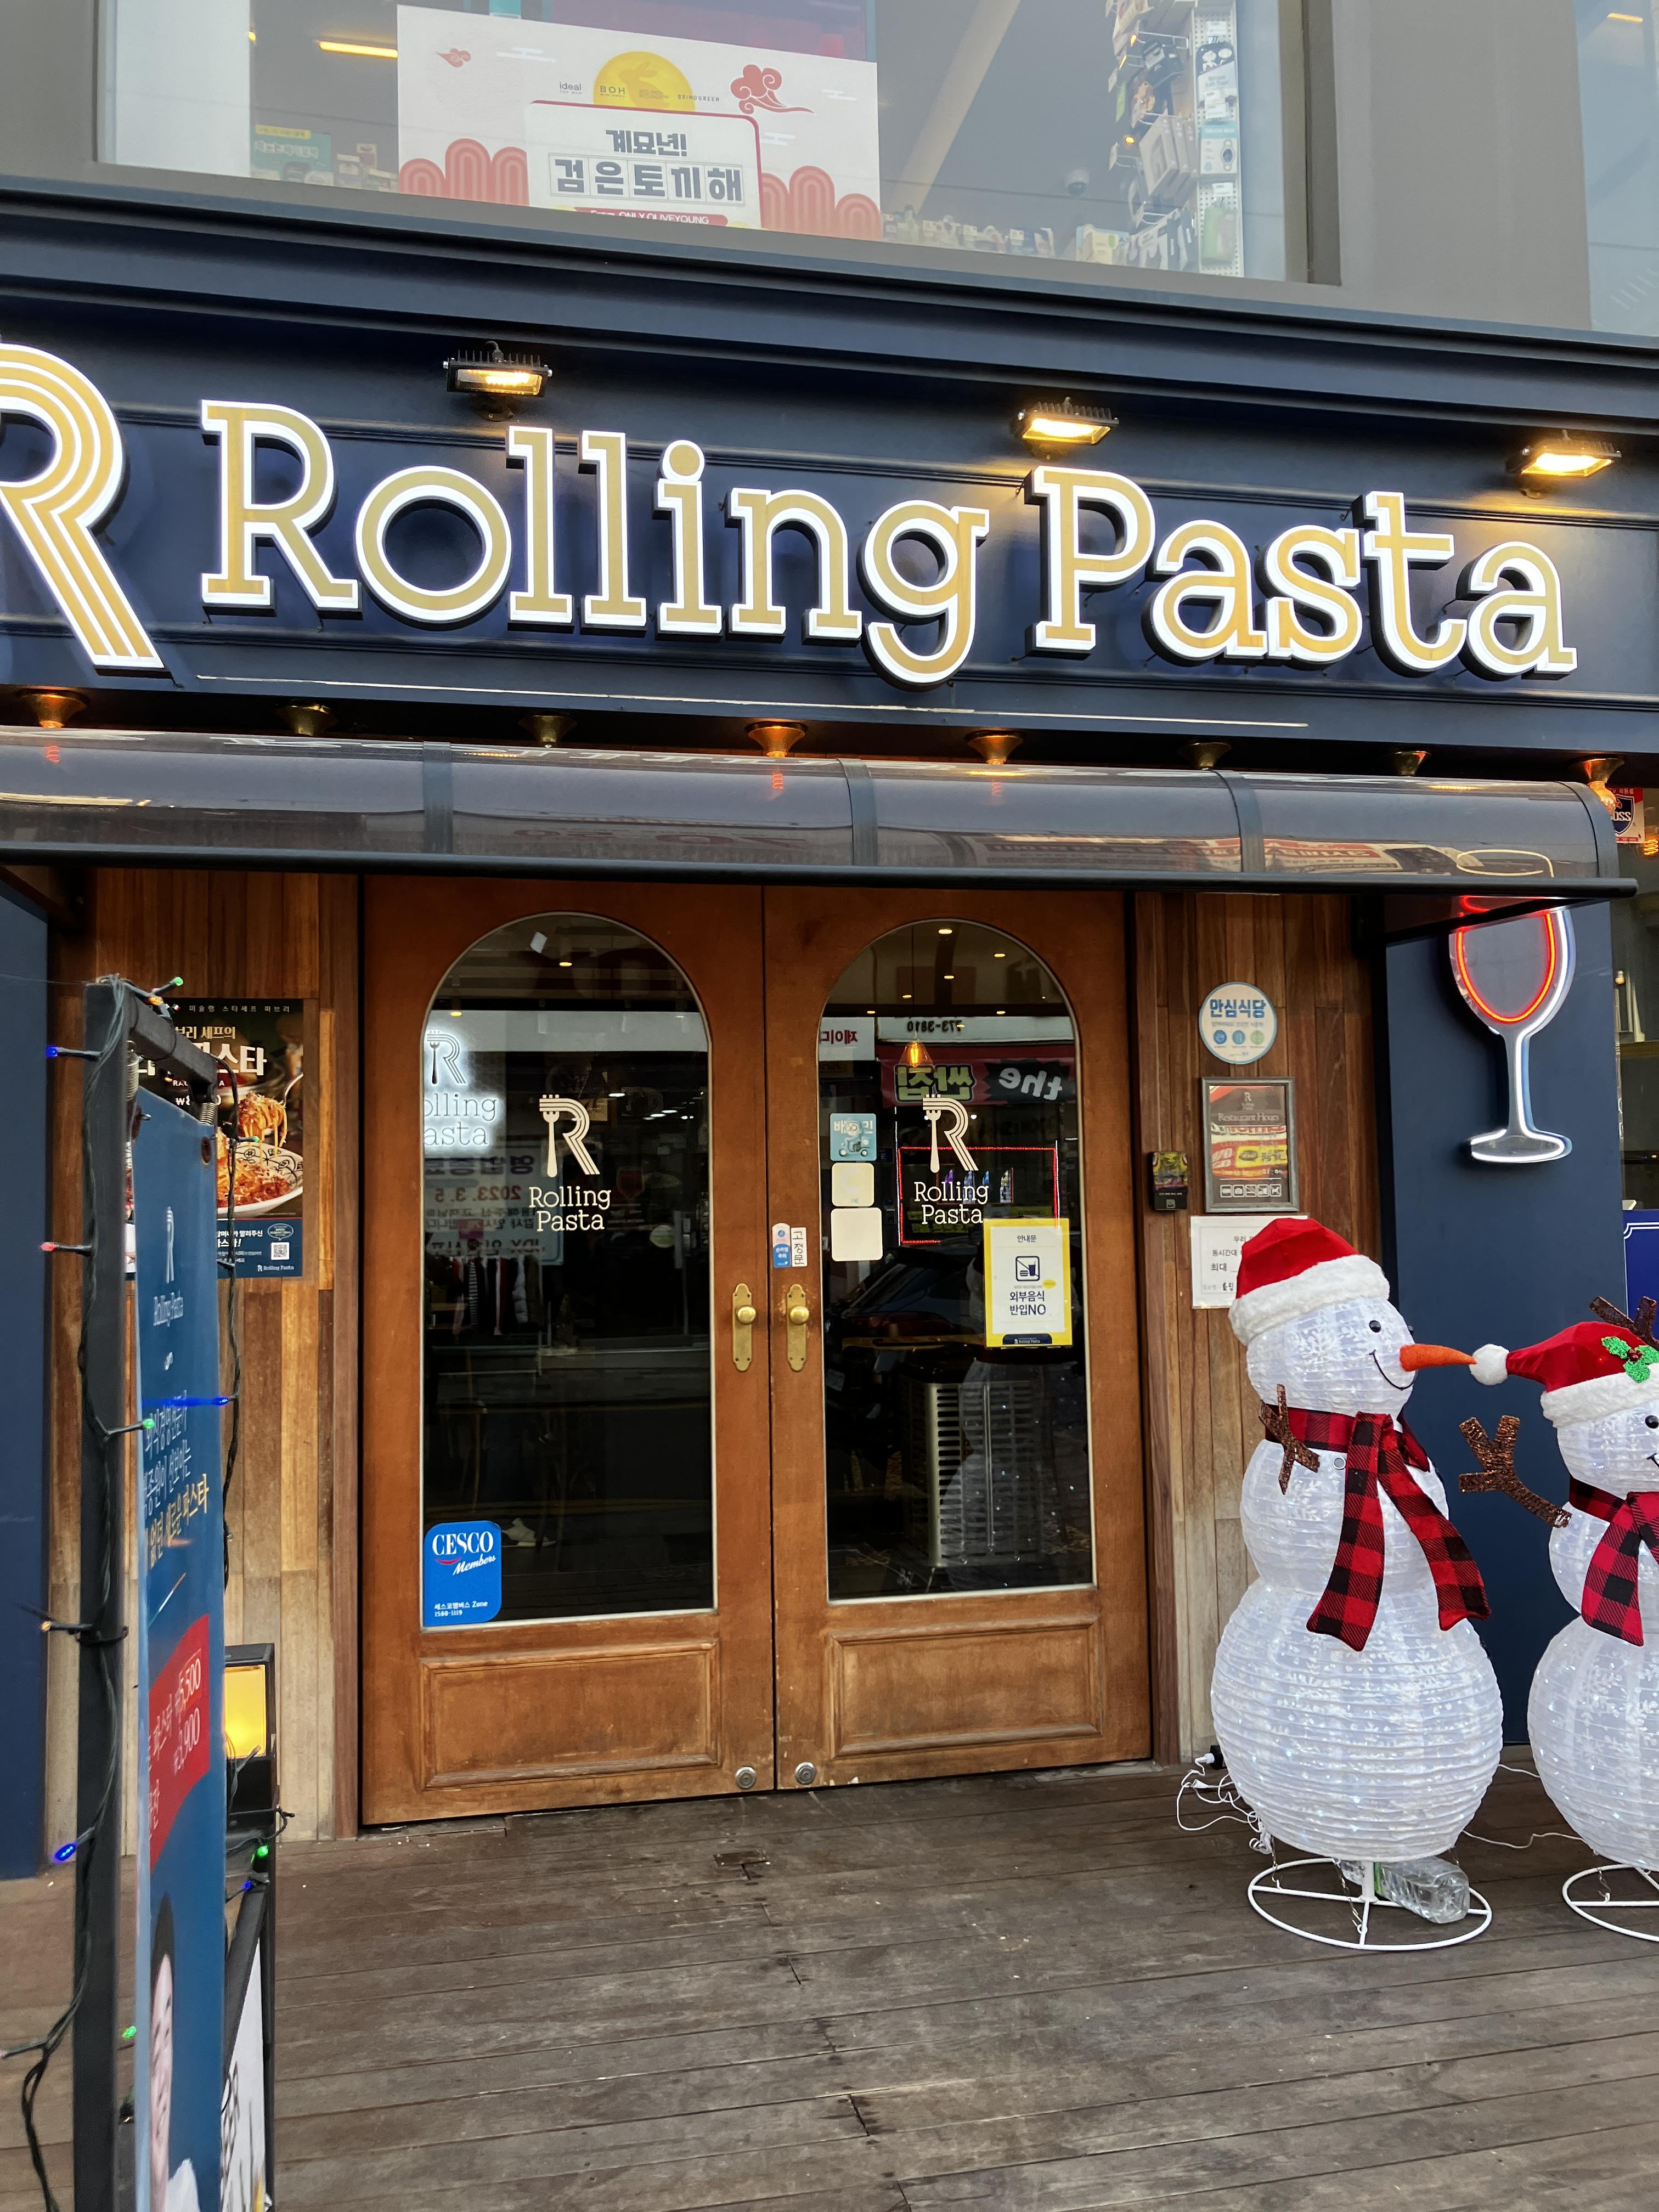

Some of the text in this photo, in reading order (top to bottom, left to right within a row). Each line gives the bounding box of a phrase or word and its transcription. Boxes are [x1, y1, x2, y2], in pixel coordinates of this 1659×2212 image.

[560, 82, 582, 91] ideal
[600, 85, 625, 94] BOH
[606, 129, 687, 156] 계묘년!
[555, 159, 742, 201] 검은토끼해
[201, 399, 1577, 684] Rolling Pasta
[1612, 811, 1632, 822] OSS
[1210, 999, 1266, 1018] 안심식당
[424, 1093, 498, 1121] olling
[1257, 1112, 1279, 1121] Hours
[424, 1121, 490, 1147] asta
[528, 1186, 612, 1210] Rolling
[913, 1181, 989, 1205] Rolling
[537, 1209, 605, 1232] Pasta
[921, 1204, 984, 1224] Pasta
[1017, 1234, 1037, 1243] 안내문
[1211, 1263, 1227, 1272] 최대
[1009, 1290, 1045, 1302] 외부음식
[183, 1473, 210, 1527] 파스타
[432, 1531, 494, 1555] CESCO
[453, 1553, 496, 1576] Members
